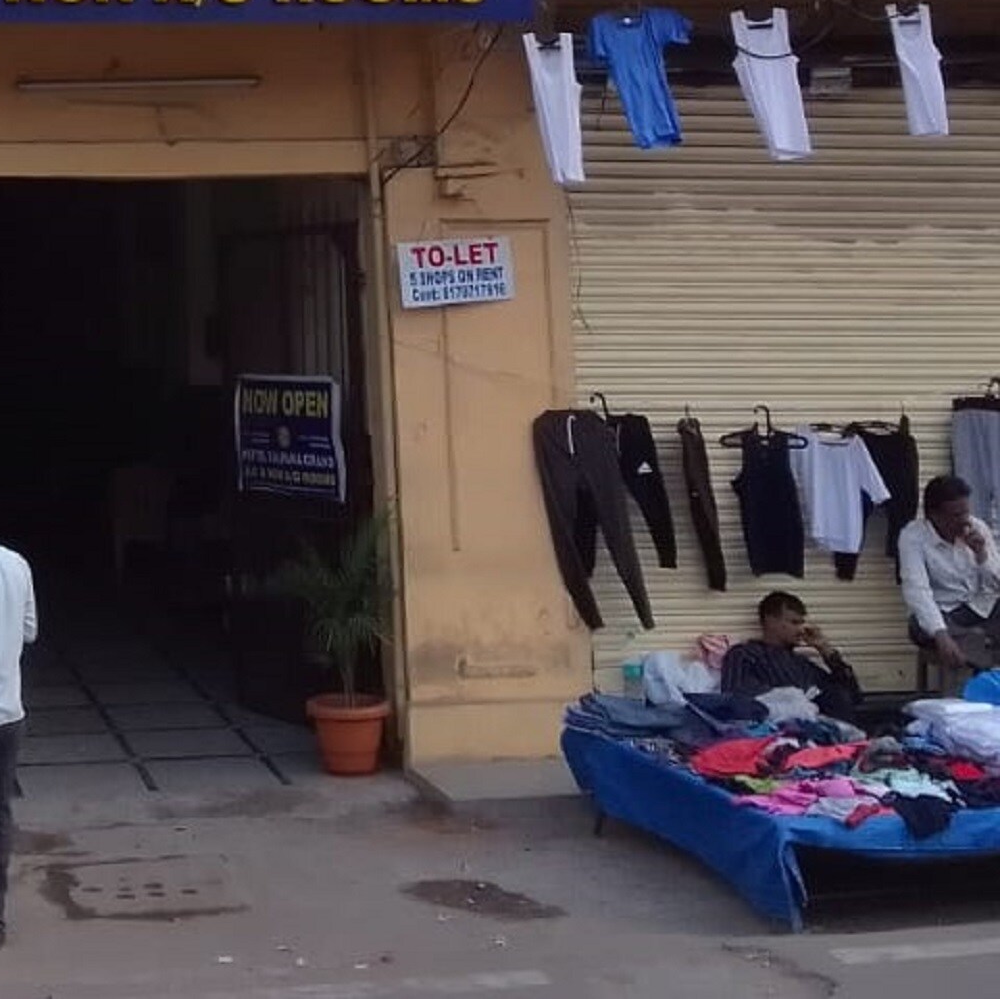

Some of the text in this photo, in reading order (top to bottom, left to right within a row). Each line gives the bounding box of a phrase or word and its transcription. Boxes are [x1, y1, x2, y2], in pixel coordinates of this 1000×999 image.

[411, 242, 498, 268] TO-LET
[457, 268, 474, 283] ON
[242, 388, 328, 418] NOW OPEN
